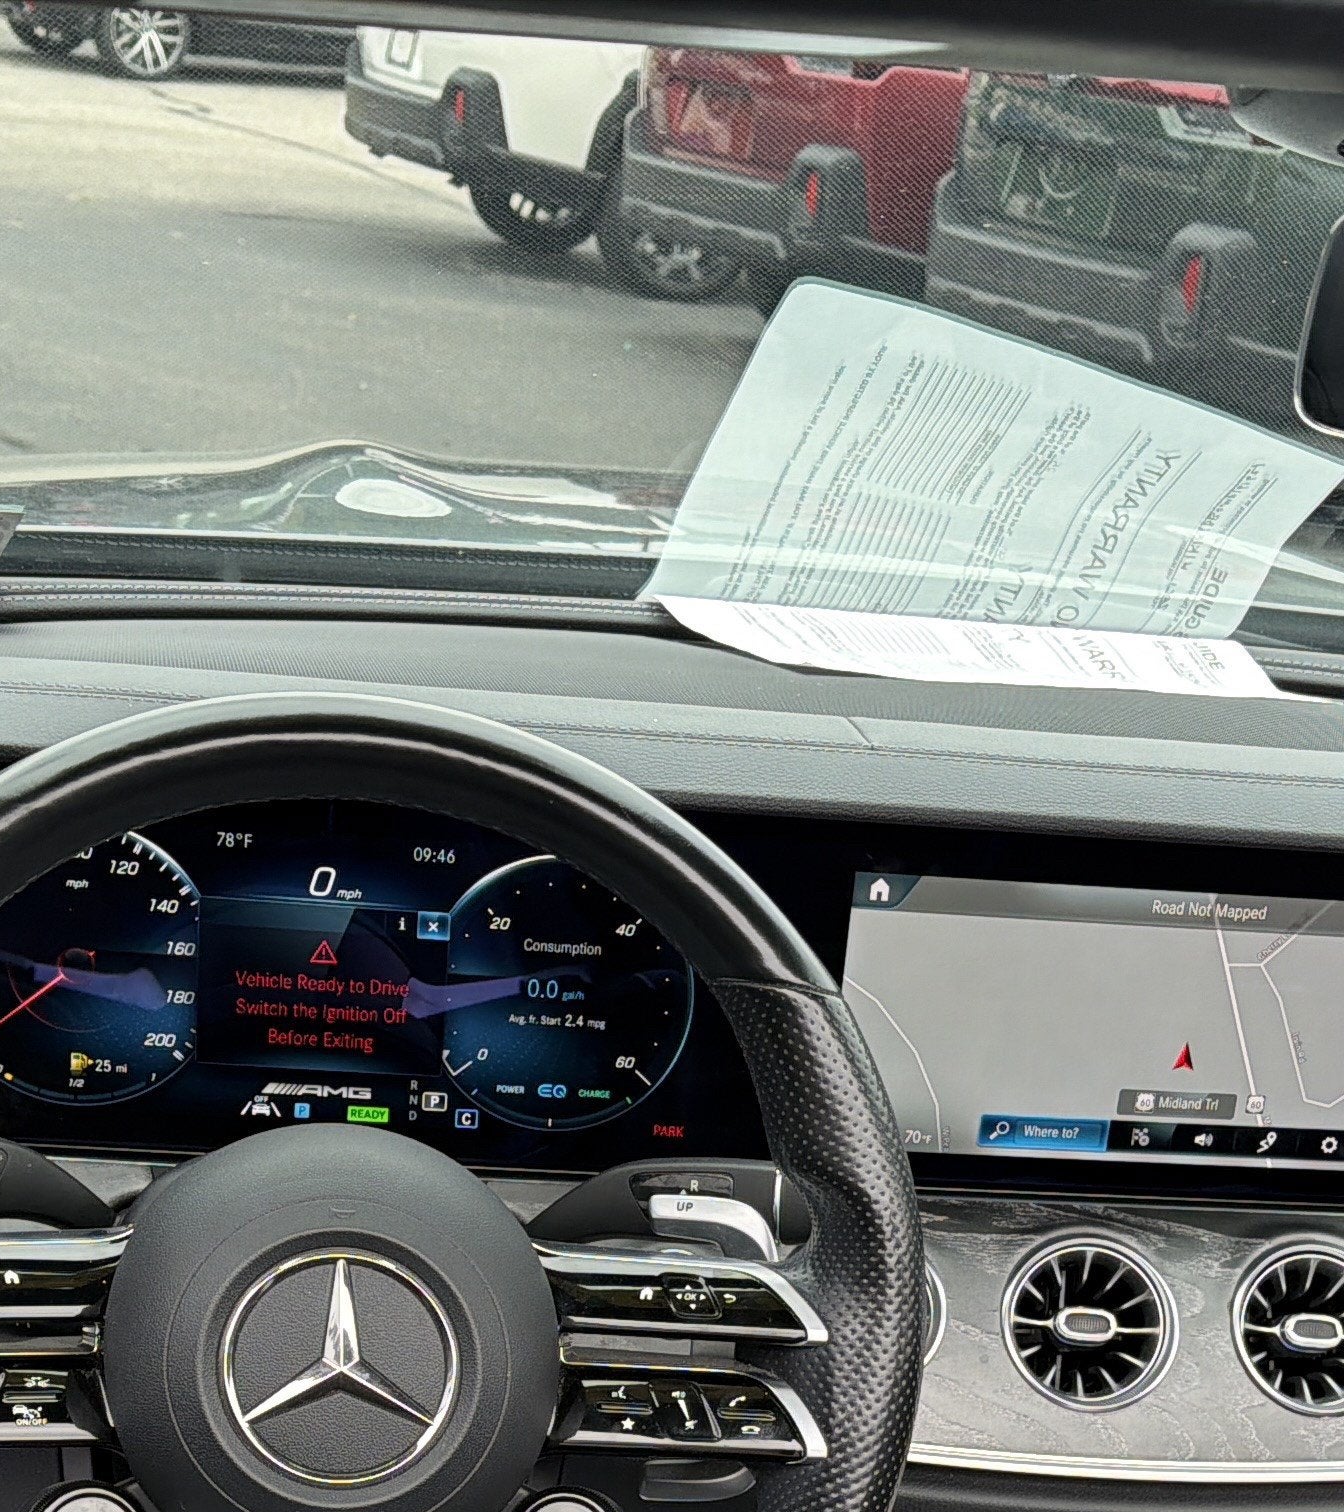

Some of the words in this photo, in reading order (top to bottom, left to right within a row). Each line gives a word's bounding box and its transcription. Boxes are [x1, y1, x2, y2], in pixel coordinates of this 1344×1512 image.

[216, 831, 253, 849] 78°F
[413, 846, 456, 865] 09:46
[108, 859, 140, 876] 120
[65, 878, 89, 889] mph
[308, 866, 337, 897] 0
[336, 888, 362, 900] mph
[148, 898, 179, 914] 140
[1152, 899, 1185, 916] Road
[1188, 902, 1211, 917] Not
[1215, 904, 1268, 922] Mapped
[489, 917, 511, 931] 20
[615, 923, 637, 937] 40
[166, 941, 196, 957] 160
[523, 937, 602, 957] Consumption
[235, 971, 292, 990] Vehicle
[297, 974, 345, 997] Ready
[349, 976, 365, 994] to
[369, 979, 410, 998] Drive
[527, 978, 558, 999] 0.0
[165, 989, 196, 1005] 180
[235, 998, 288, 1018] Switch
[293, 1000, 318, 1019] the
[323, 1003, 378, 1024] Ignition
[383, 1007, 409, 1024] Off
[540, 1014, 561, 1026] Start
[564, 1013, 584, 1027] 2.4
[587, 1019, 606, 1031] mpg
[144, 1032, 177, 1048] 200
[267, 1028, 318, 1046] Before
[322, 1031, 375, 1053] Exiting
[477, 1048, 489, 1061] 0
[94, 1059, 112, 1073] 25
[115, 1063, 128, 1074] mi
[615, 1056, 636, 1069] 60
[410, 1080, 418, 1090] R
[495, 1084, 525, 1095] POWER
[409, 1095, 418, 1105] N
[578, 1088, 611, 1099] CHARGE
[430, 1094, 439, 1108] P
[1158, 1095, 1202, 1111] Midland
[349, 1109, 386, 1121] READY
[408, 1111, 417, 1121] D
[461, 1112, 471, 1125] C
[652, 1124, 685, 1137] PARK
[1024, 1124, 1058, 1138] Where
[1061, 1126, 1080, 1140] to?
[690, 1180, 699, 1192] R
[675, 1201, 694, 1213] UP
[683, 1292, 698, 1302] OK
[15, 1417, 48, 1427] ON/OFF
